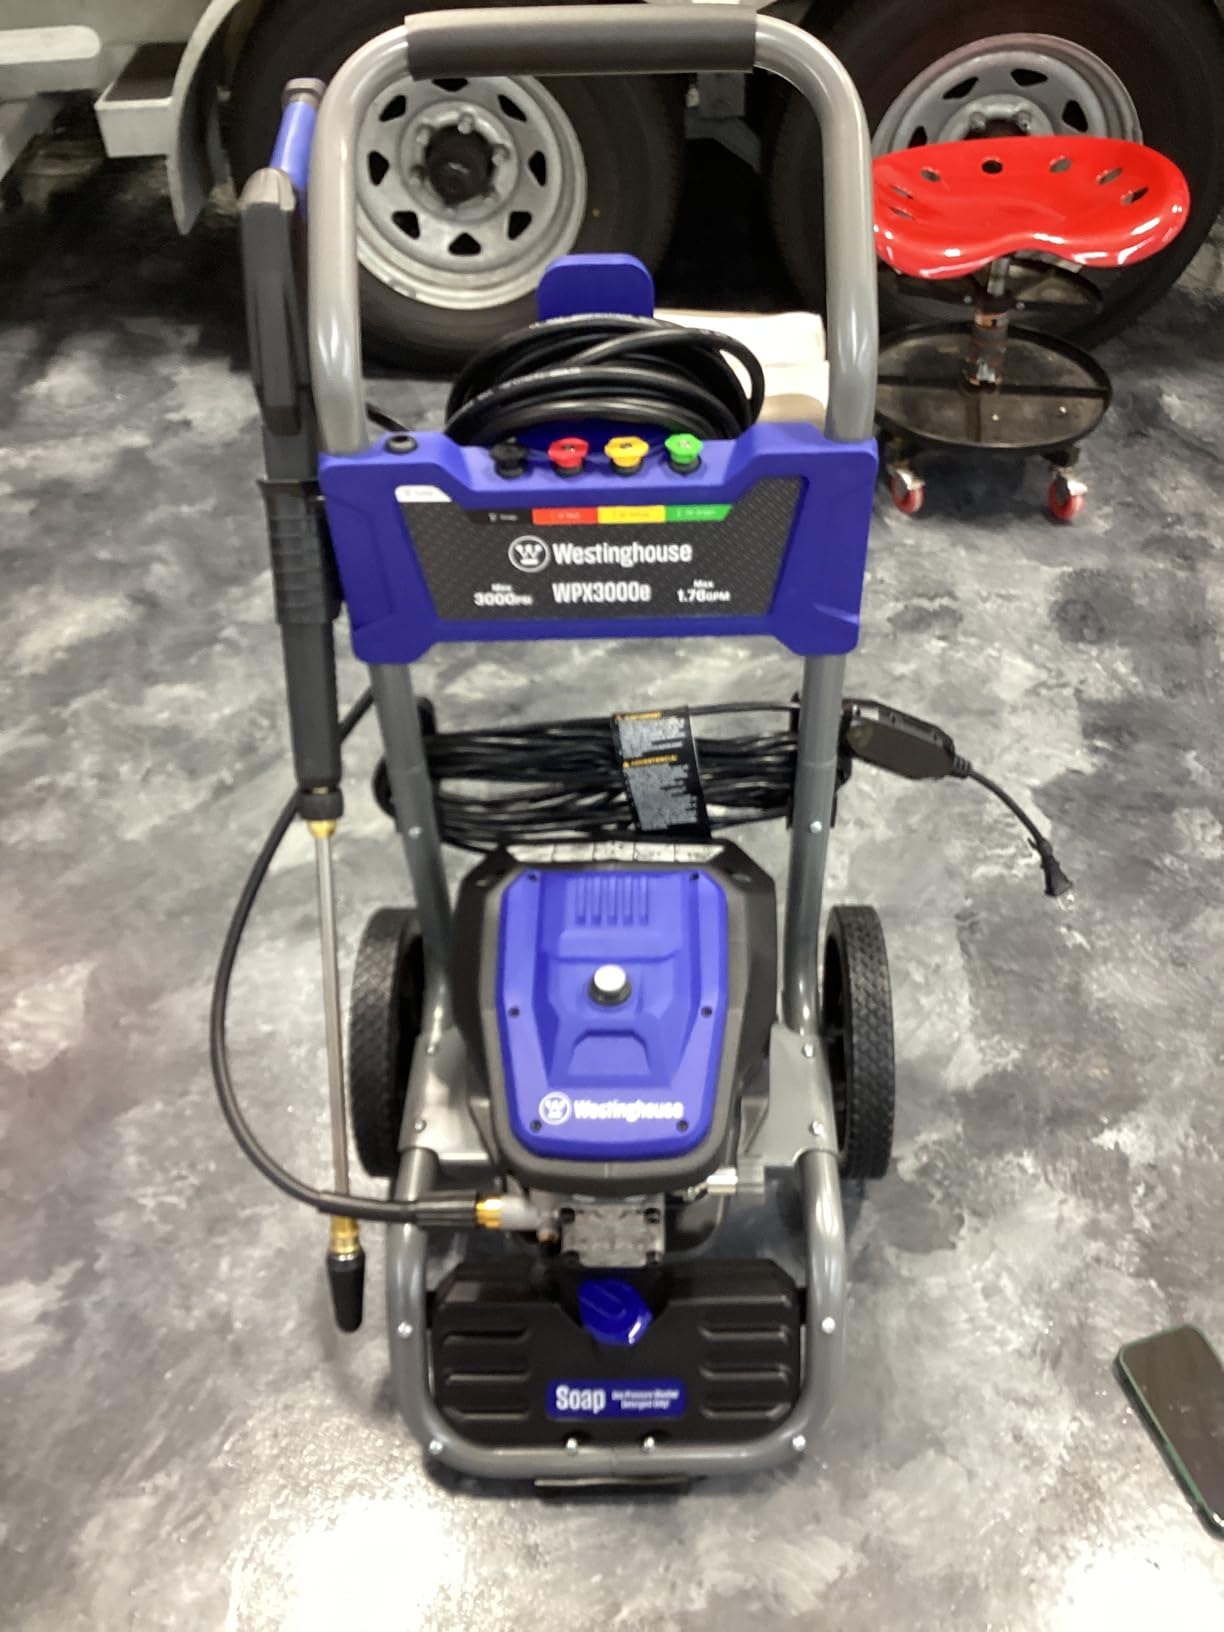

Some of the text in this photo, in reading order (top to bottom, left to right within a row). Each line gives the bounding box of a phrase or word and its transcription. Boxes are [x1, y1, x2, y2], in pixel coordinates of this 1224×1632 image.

[552, 541, 693, 568] Westinghouse
[552, 581, 652, 604] WPX3000e
[555, 1384, 606, 1415] Soap
